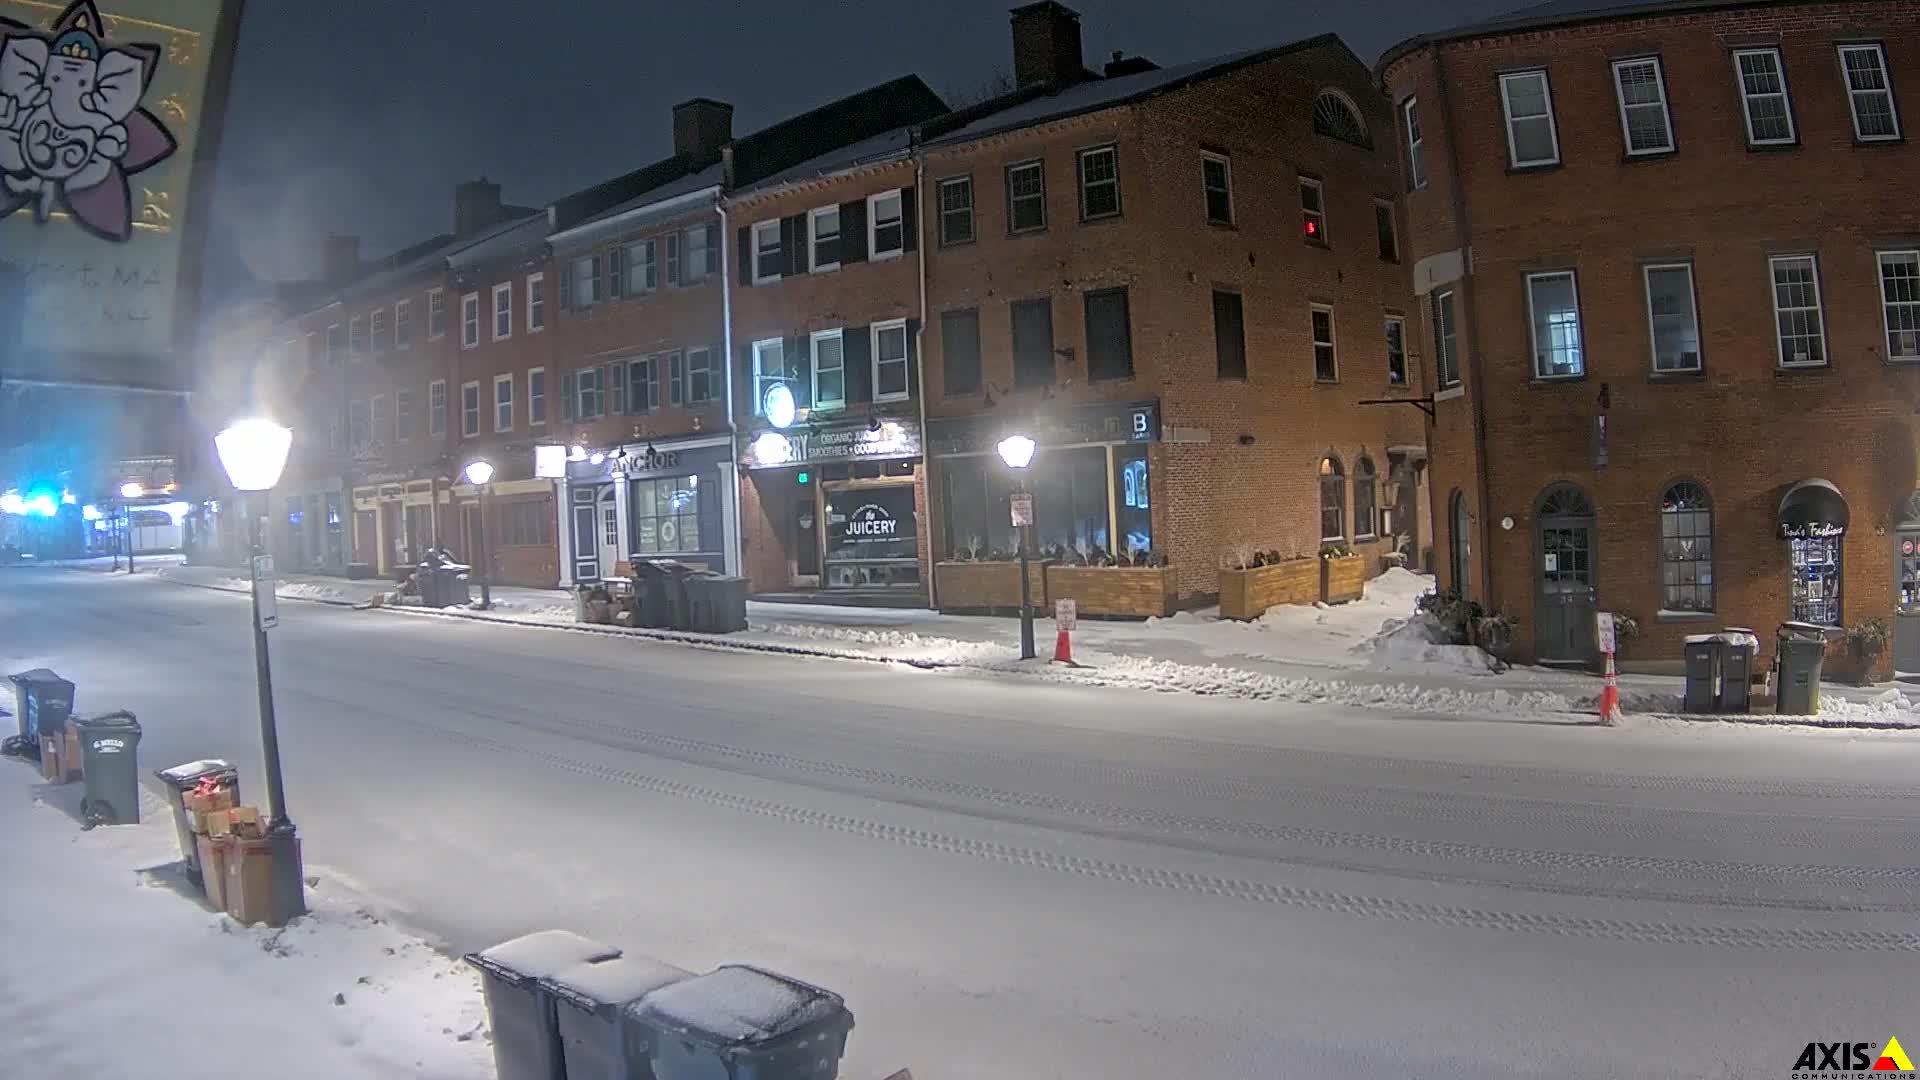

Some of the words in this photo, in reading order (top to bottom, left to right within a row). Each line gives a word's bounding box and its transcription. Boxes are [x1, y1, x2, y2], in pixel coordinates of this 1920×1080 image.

[1133, 412, 1147, 432] B
[611, 452, 680, 472] ANCHOR
[845, 520, 896, 535] JUICERY
